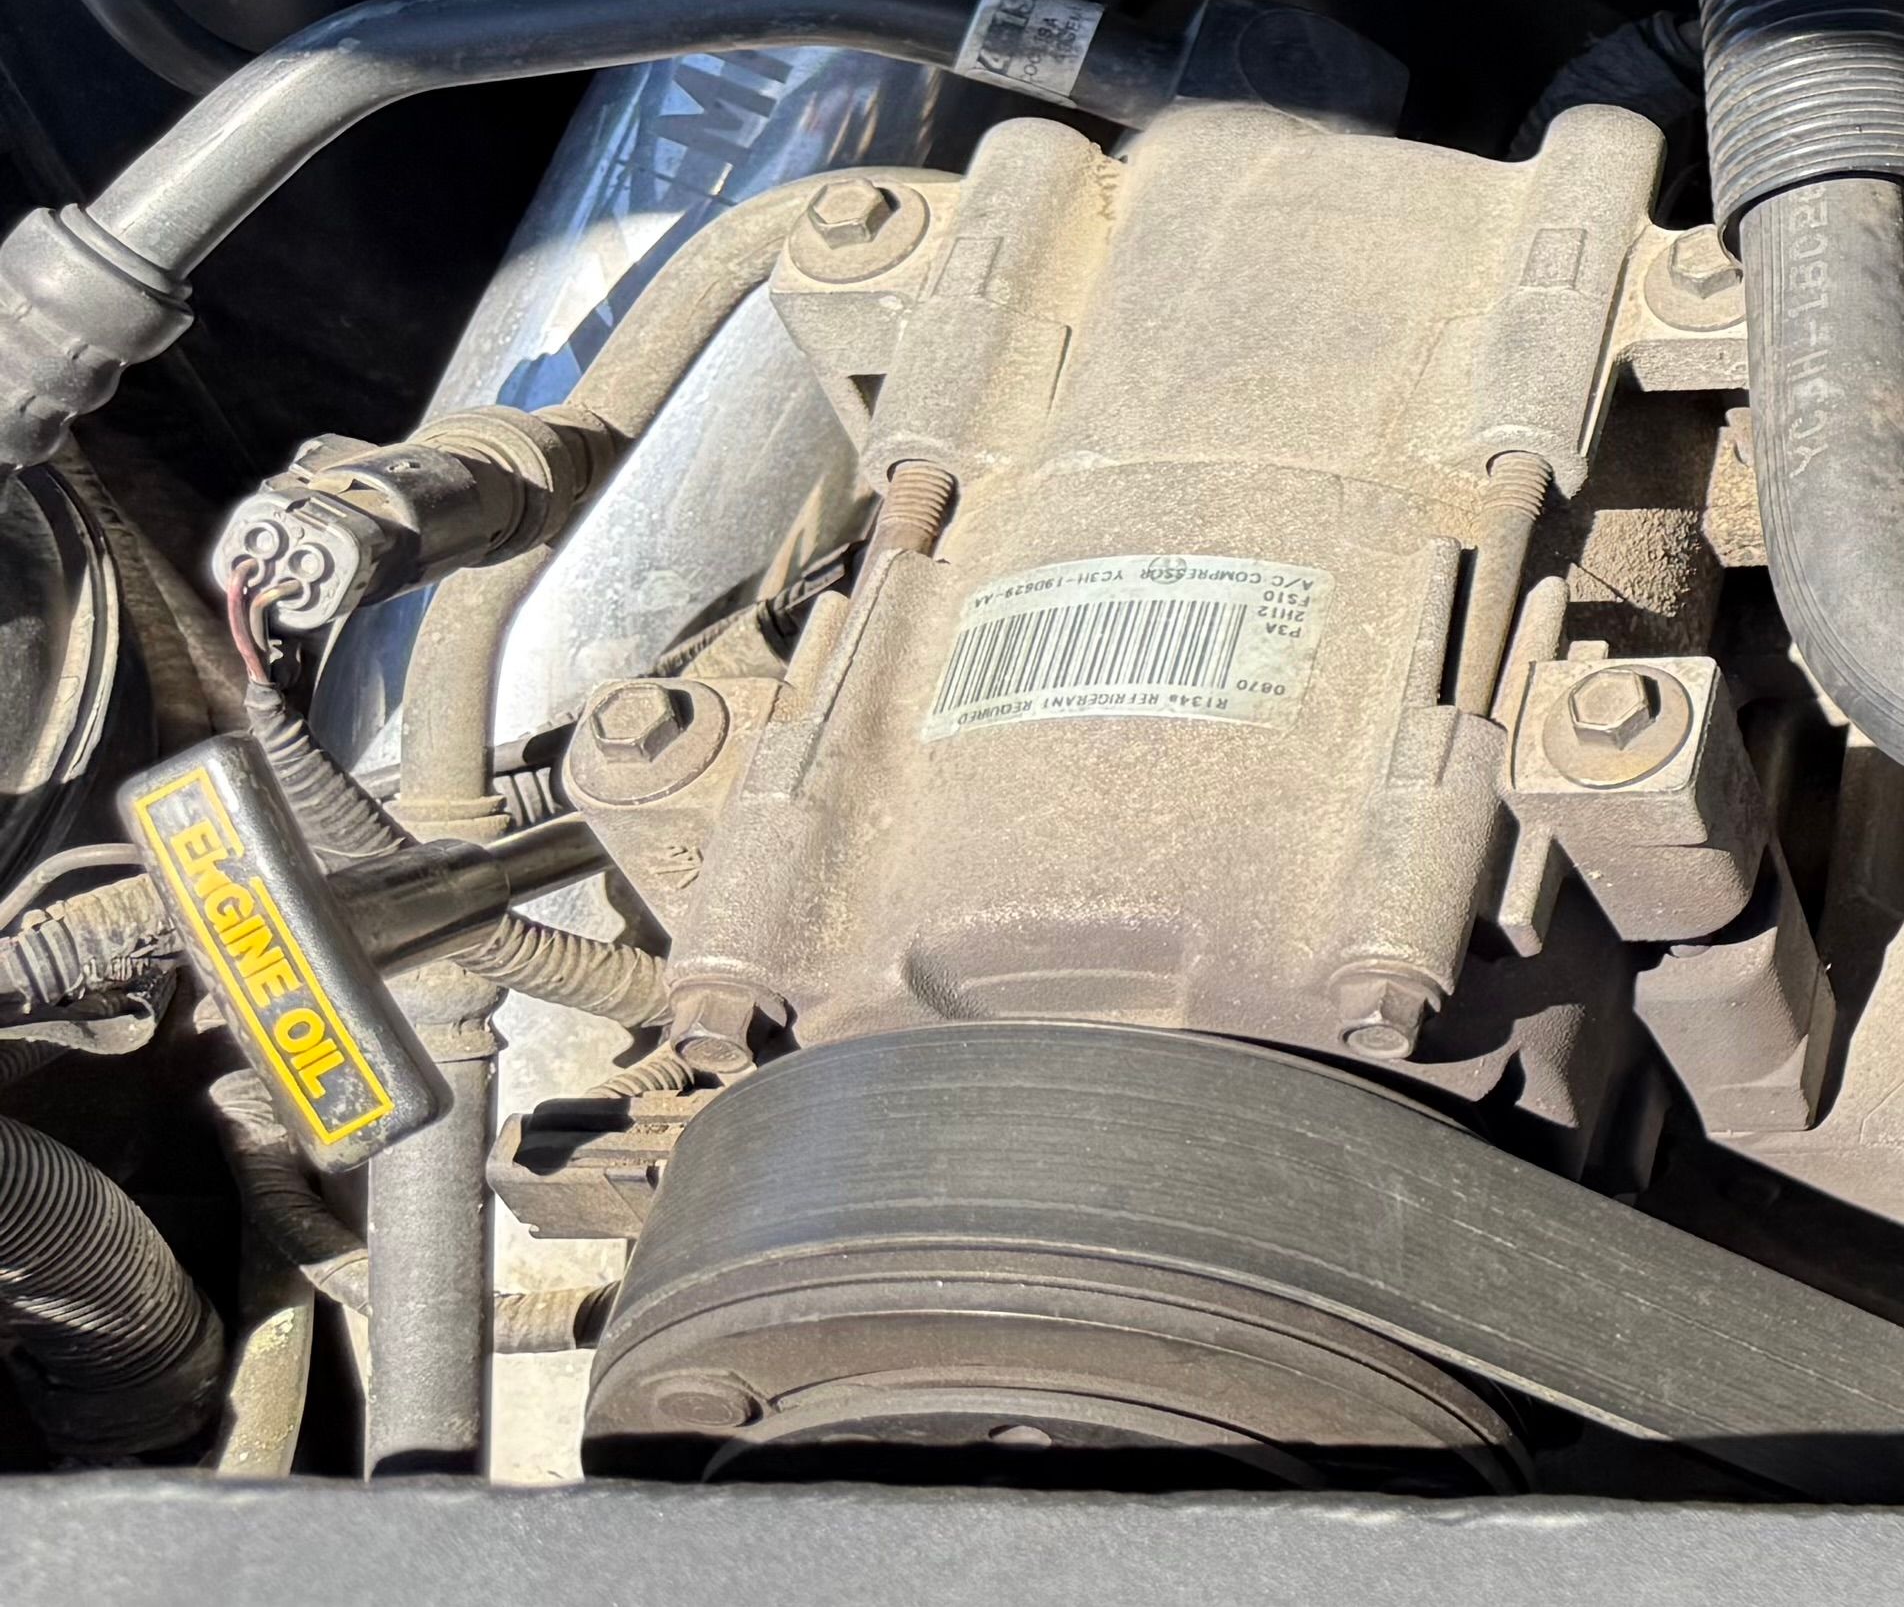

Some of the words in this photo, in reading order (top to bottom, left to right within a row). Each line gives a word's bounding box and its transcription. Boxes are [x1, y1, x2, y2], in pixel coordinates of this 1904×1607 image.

[1139, 566, 1261, 585] COMPRESSOR
[1270, 573, 1315, 591] A/C
[1263, 590, 1311, 607] FS10
[1265, 621, 1302, 638] P3A
[1236, 678, 1286, 695] 0870
[1042, 692, 1159, 708] REFRIGERANT
[957, 698, 1033, 726] REQUIRED
[273, 1007, 345, 1099] OIL
